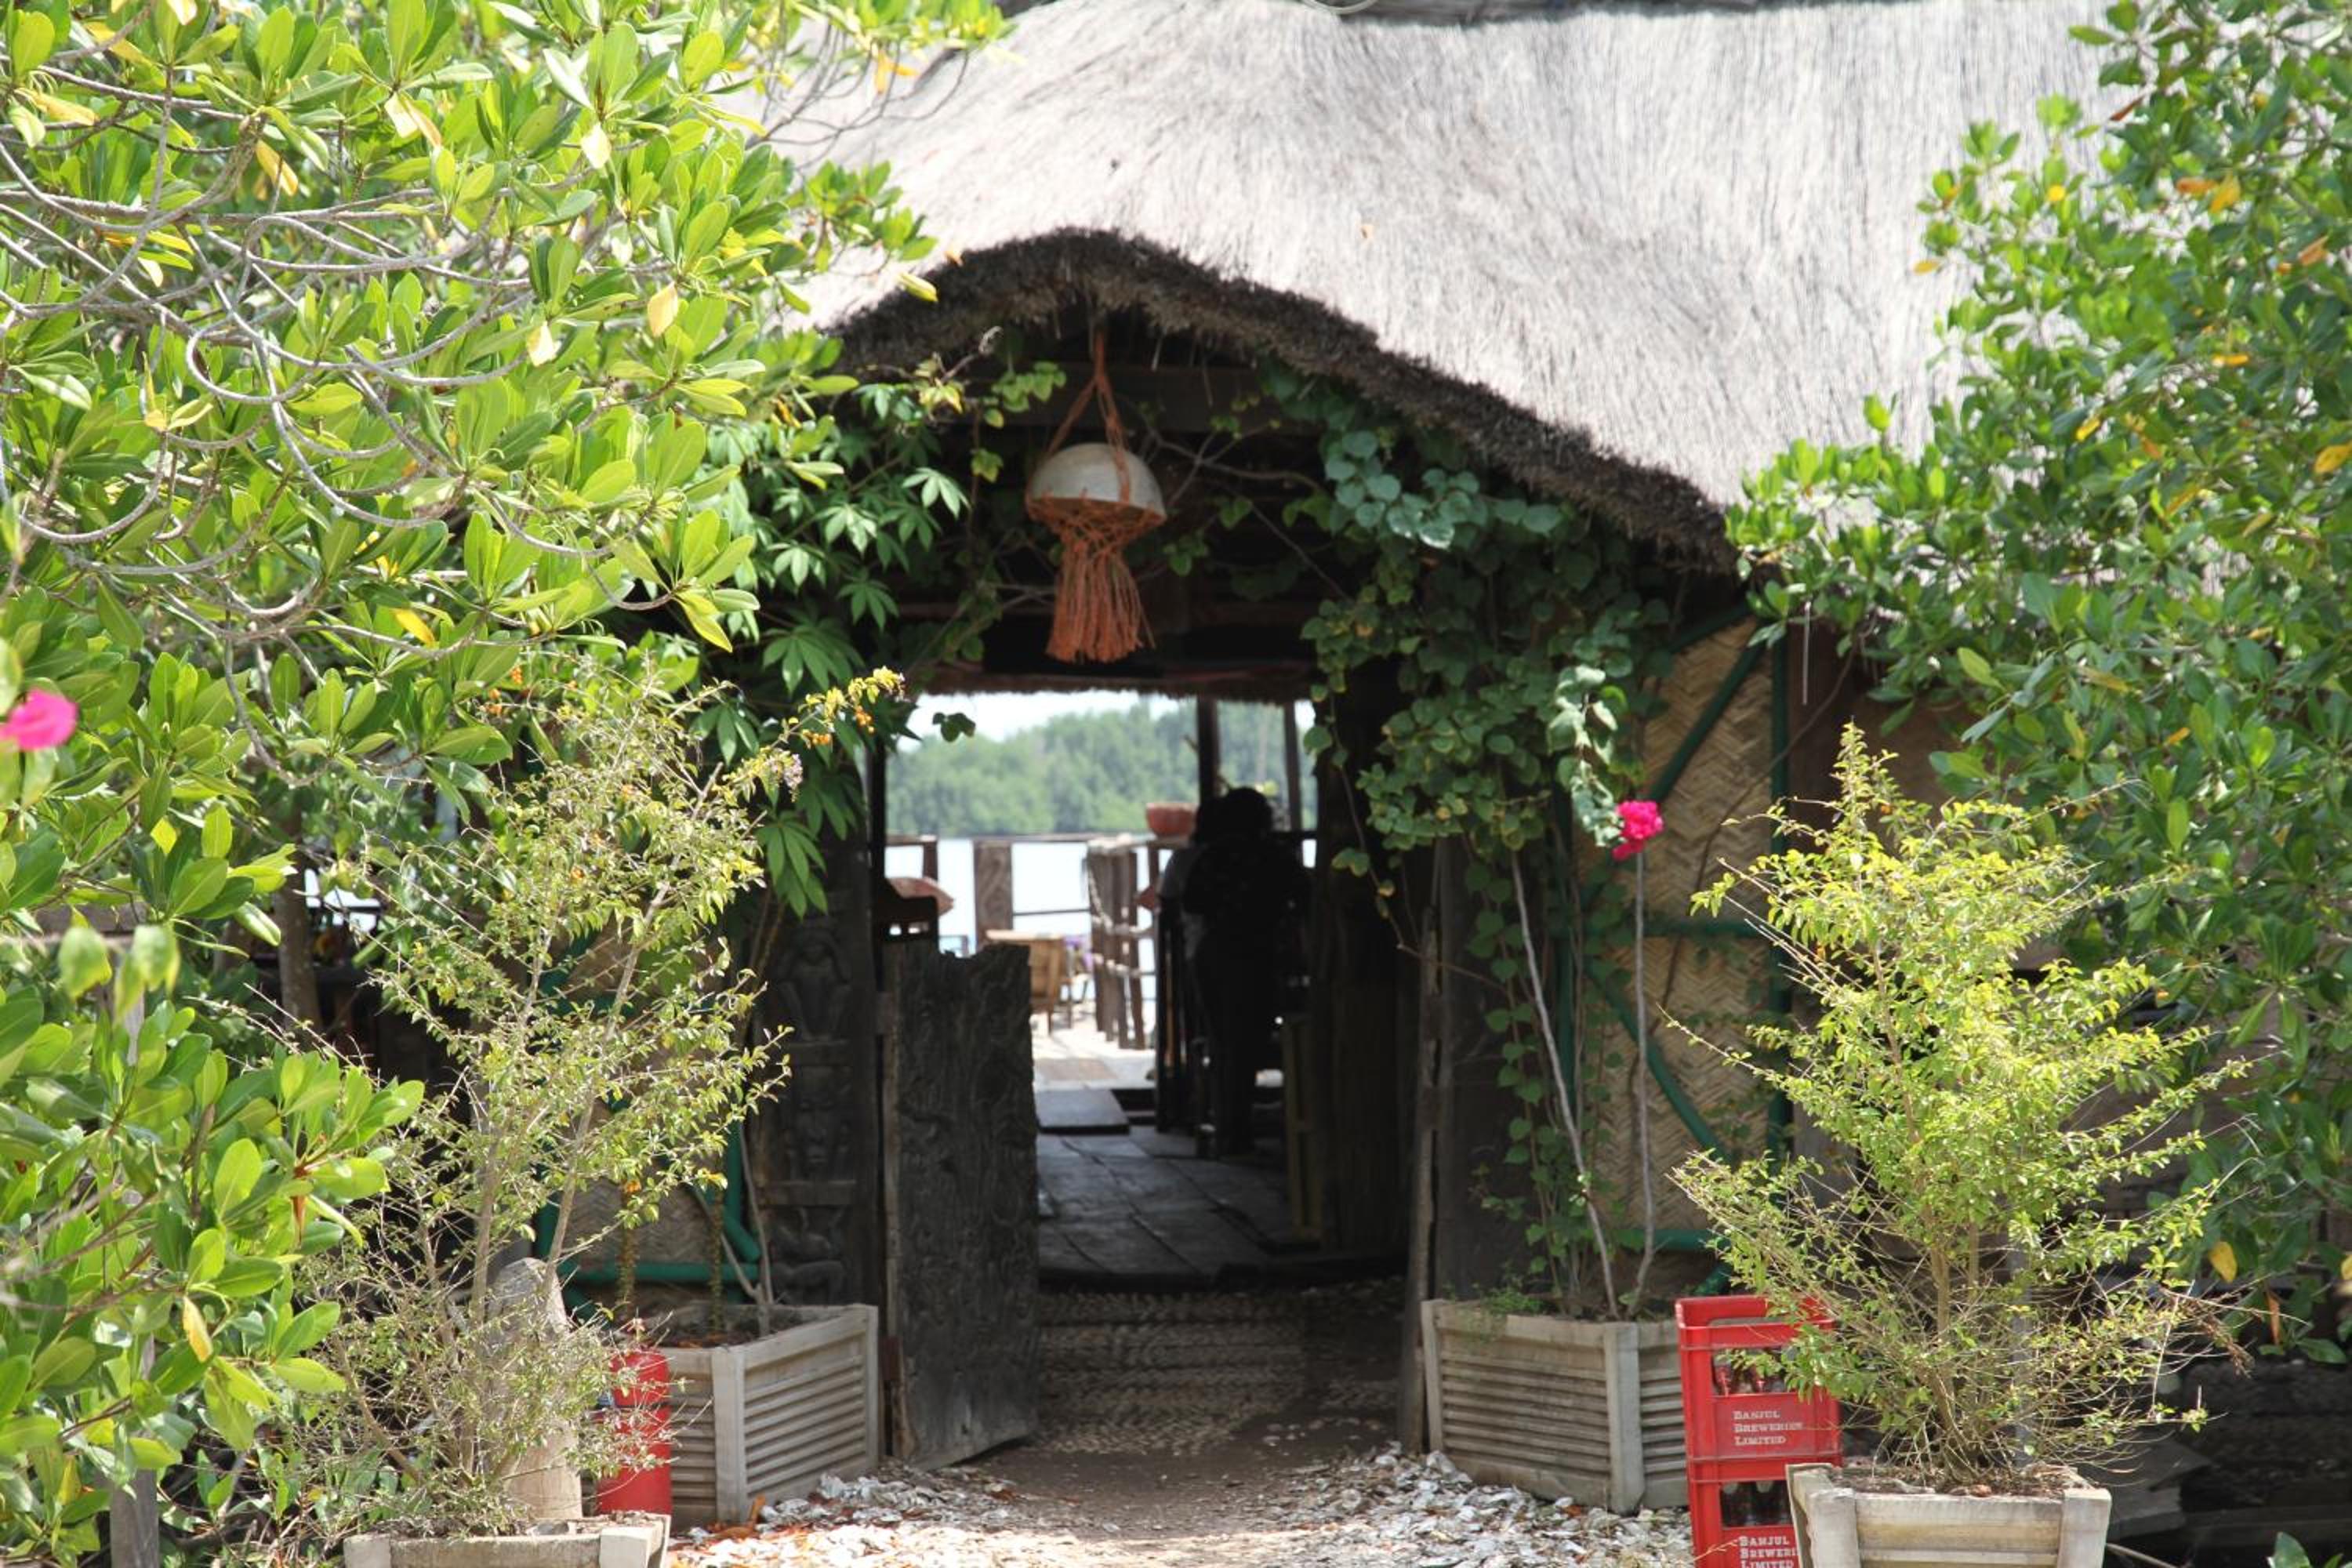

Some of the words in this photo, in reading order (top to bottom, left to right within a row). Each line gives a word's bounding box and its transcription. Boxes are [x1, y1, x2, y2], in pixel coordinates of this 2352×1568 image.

[1733, 1410, 1780, 1420] BANJUL
[1734, 1436, 1787, 1446] LIMITED
[1738, 1536, 1790, 1546] BANJUL
[1740, 1559, 1795, 1568] LIMITED
